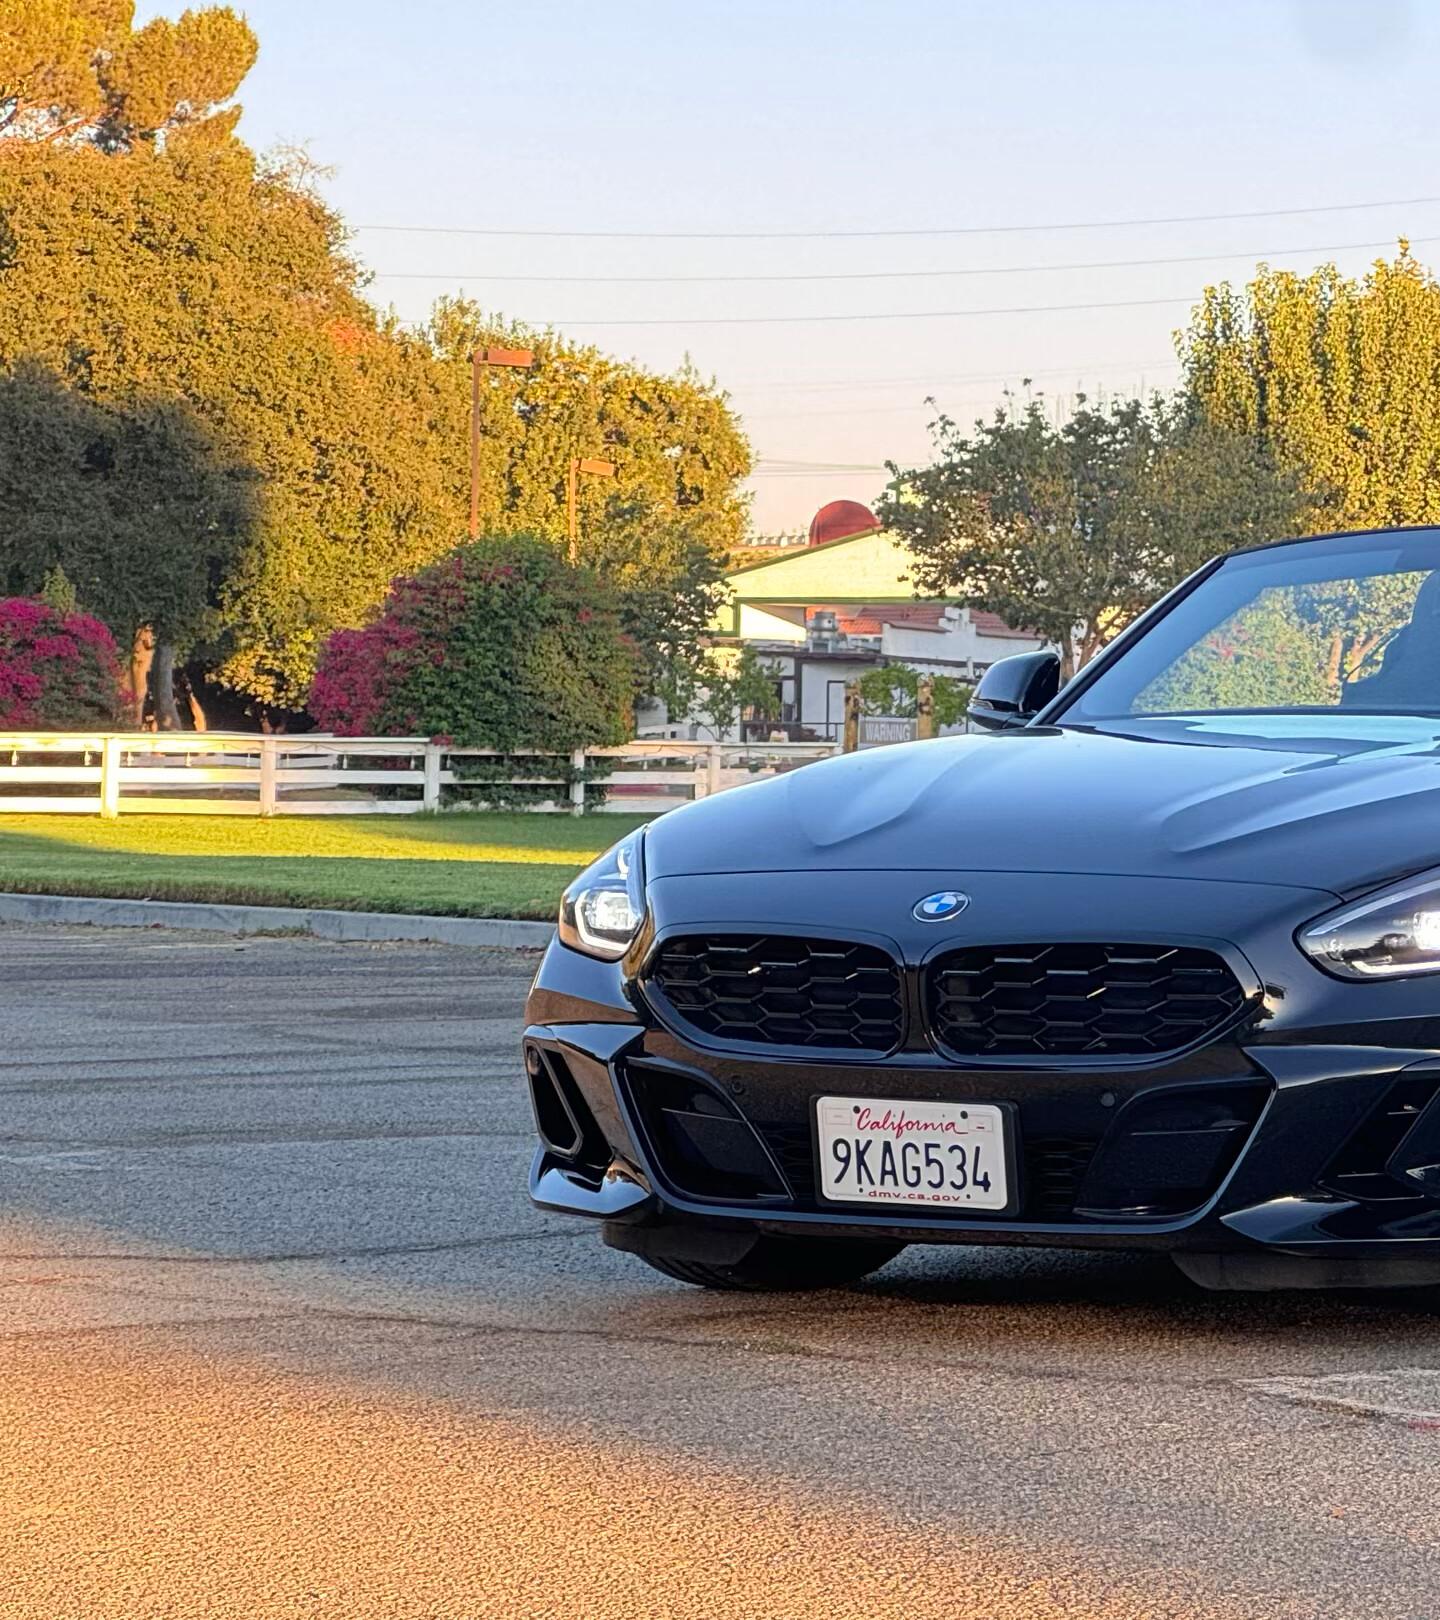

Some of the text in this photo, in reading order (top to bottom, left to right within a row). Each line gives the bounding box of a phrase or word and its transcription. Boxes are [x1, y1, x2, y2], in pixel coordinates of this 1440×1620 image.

[866, 722, 911, 741] WARNING
[857, 1108, 968, 1138] California
[833, 1138, 991, 1192] 9KAG534
[868, 1189, 961, 1202] dmv.ca.gov
